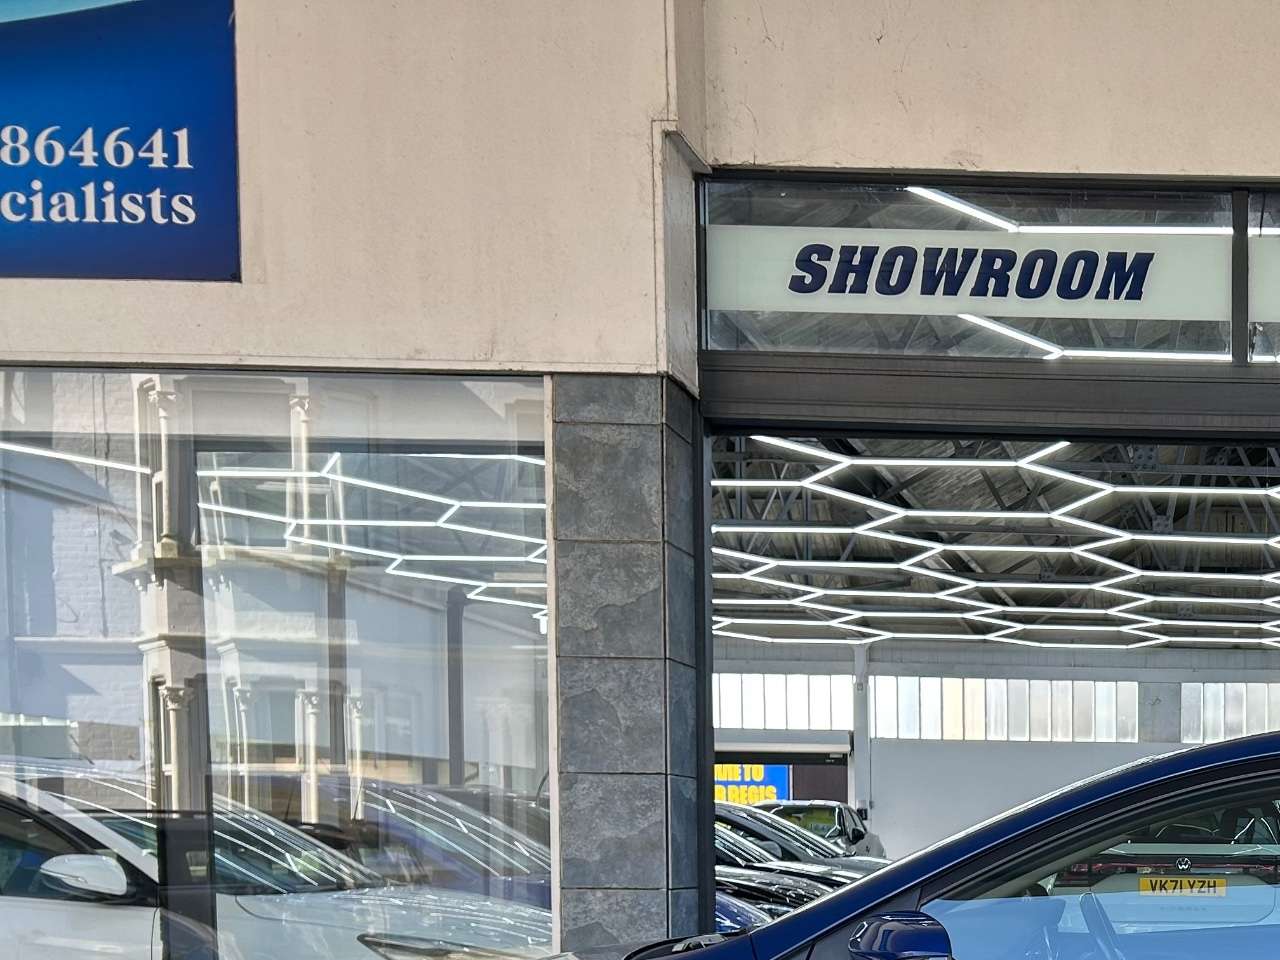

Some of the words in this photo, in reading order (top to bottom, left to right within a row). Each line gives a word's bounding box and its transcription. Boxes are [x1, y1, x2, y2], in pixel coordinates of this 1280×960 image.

[0, 124, 195, 170] 864641
[0, 179, 197, 225] cialists
[787, 242, 1156, 302] SHOWROOM
[1150, 879, 1183, 894] VK71
[1186, 879, 1217, 894] YZH
